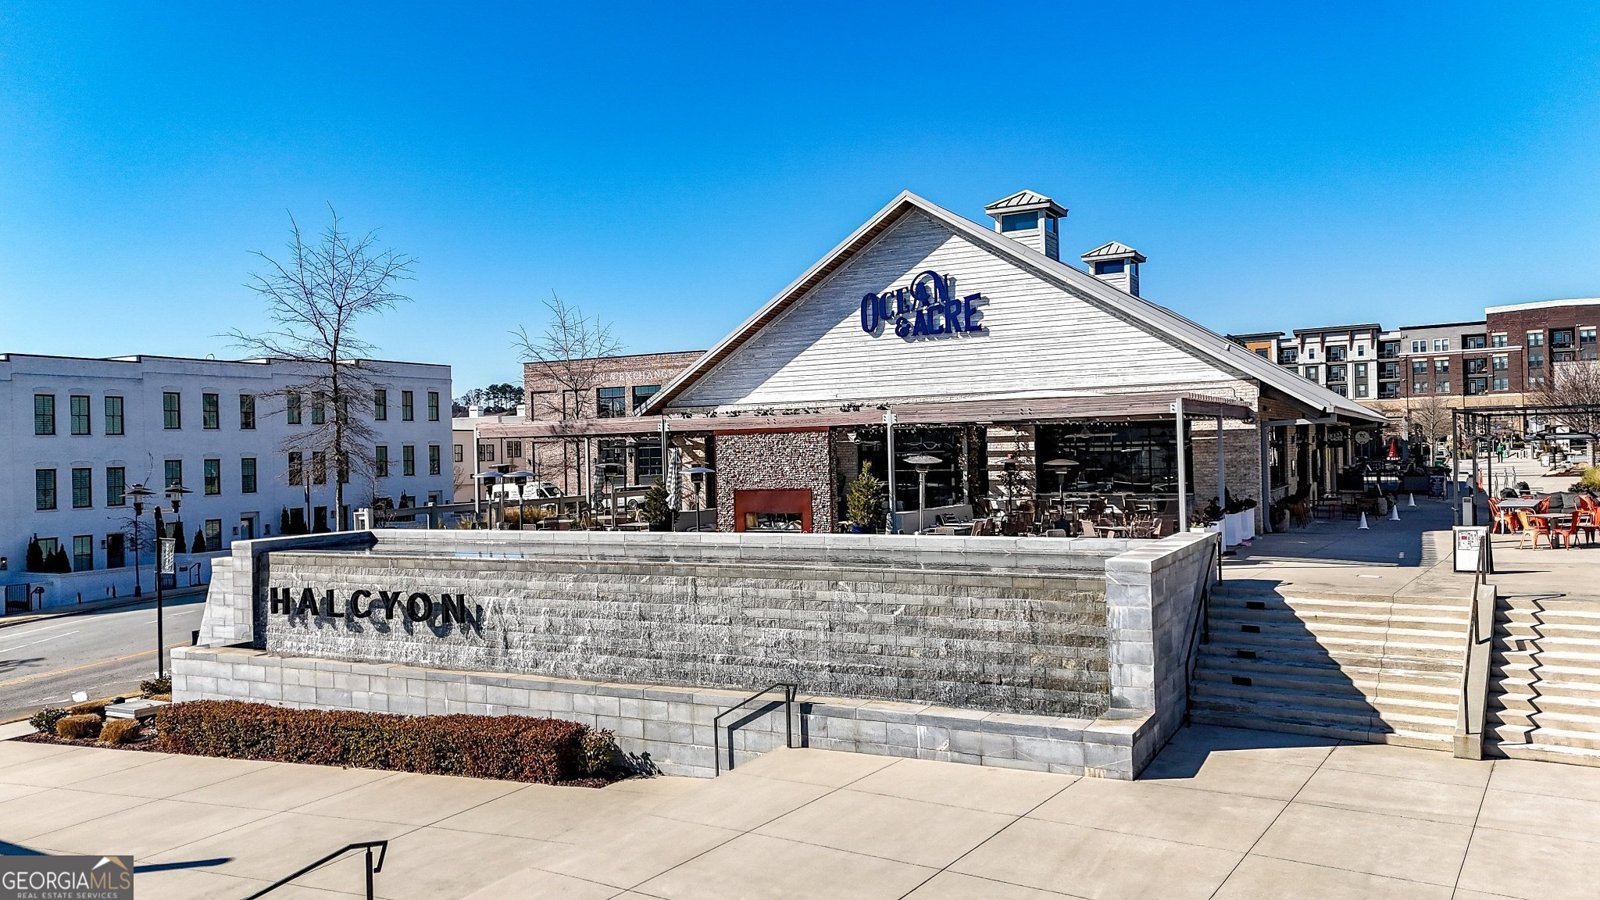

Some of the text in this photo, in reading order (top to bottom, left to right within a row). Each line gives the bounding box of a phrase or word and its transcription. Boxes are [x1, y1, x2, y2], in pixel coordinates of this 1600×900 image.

[861, 270, 950, 333] OCEAN
[895, 293, 983, 338] & ACRE
[619, 369, 675, 382] EXCHANGE
[270, 587, 466, 624] HALCYON
